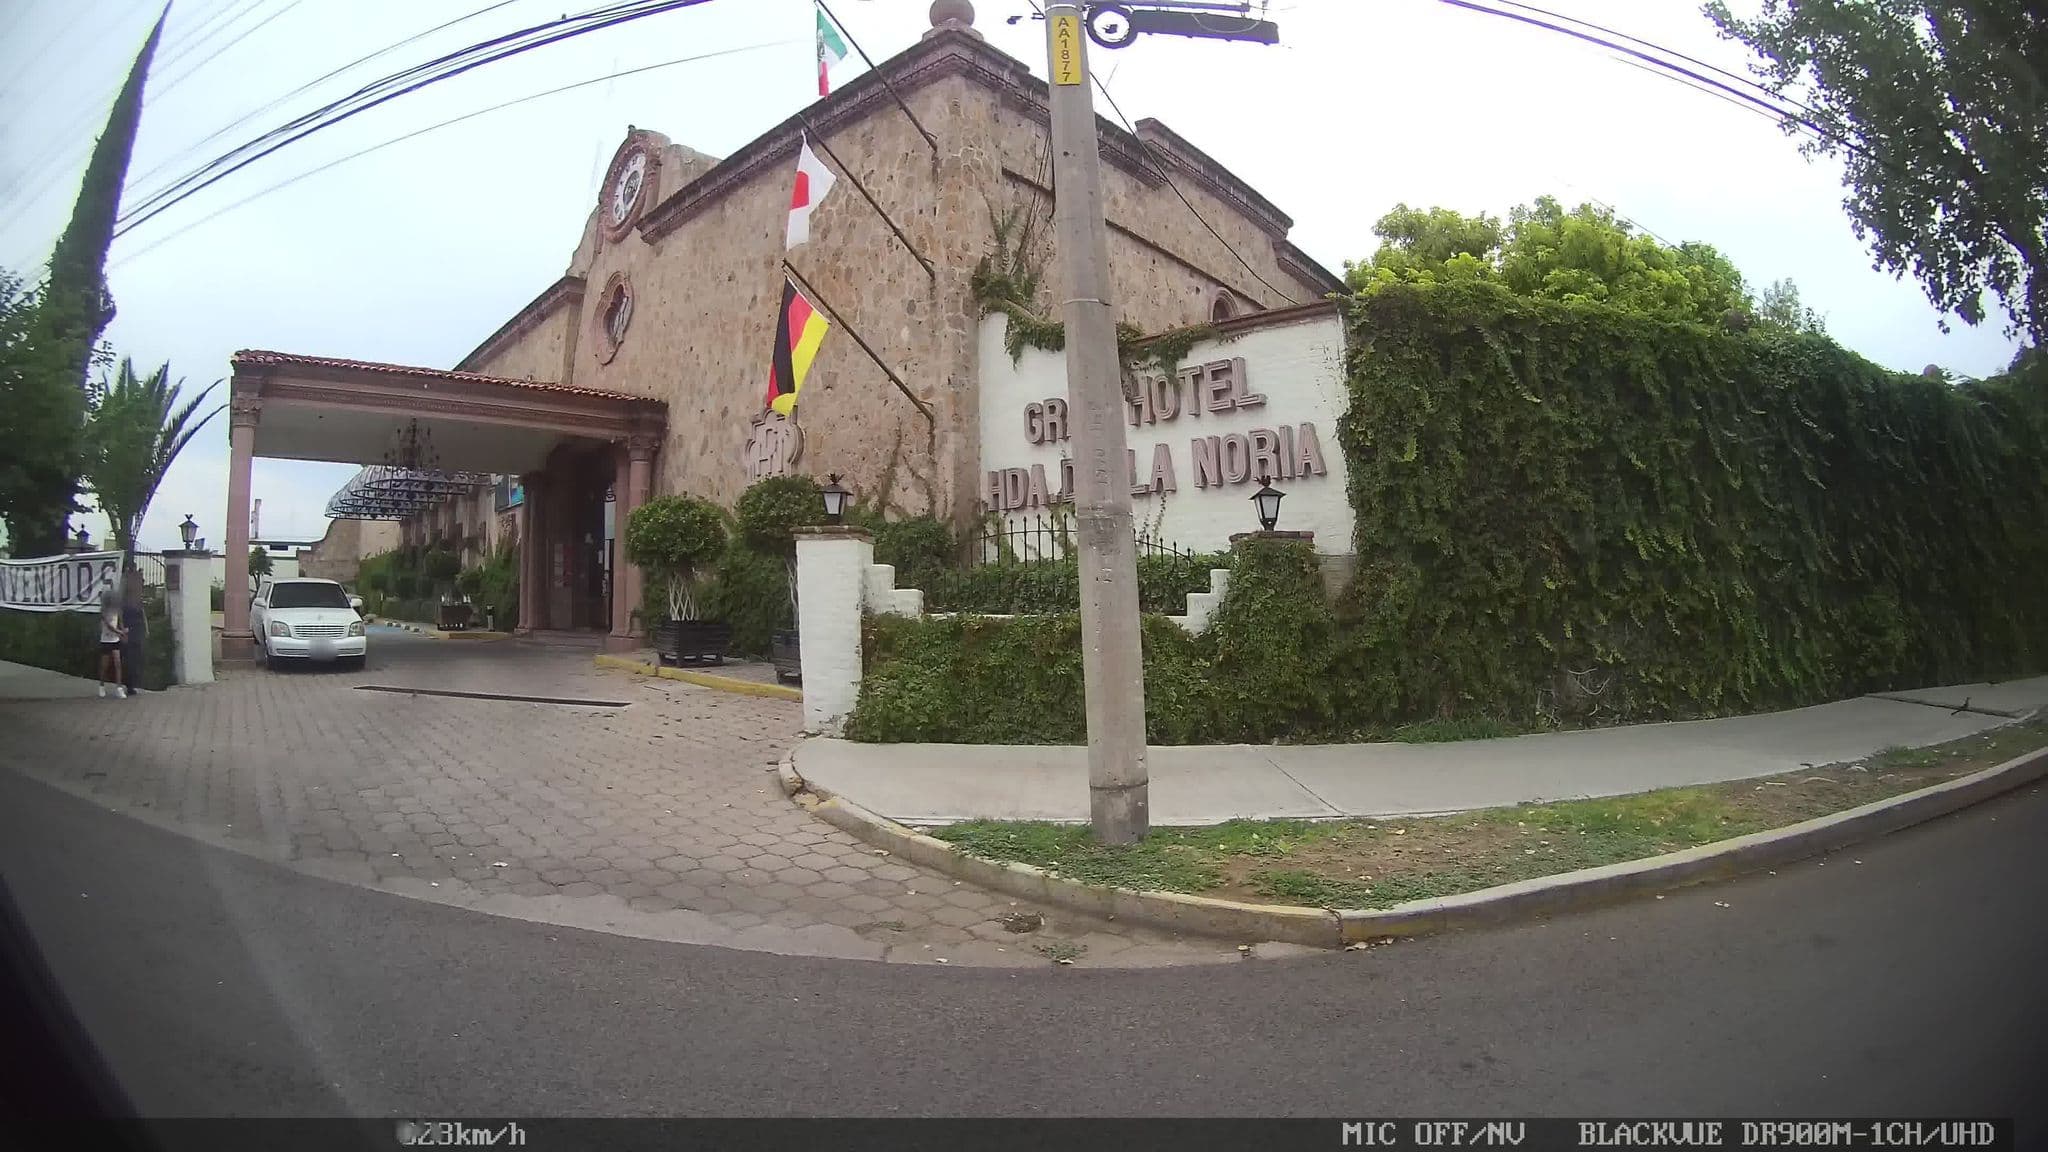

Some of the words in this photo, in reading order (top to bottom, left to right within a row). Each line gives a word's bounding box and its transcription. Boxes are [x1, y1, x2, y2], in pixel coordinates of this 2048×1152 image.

[1058, 17, 1071, 82] AA1877
[1023, 398, 1070, 445] GR
[1125, 357, 1268, 426] HOTEL
[1128, 443, 1177, 496] LA
[1191, 422, 1327, 488] NORIA
